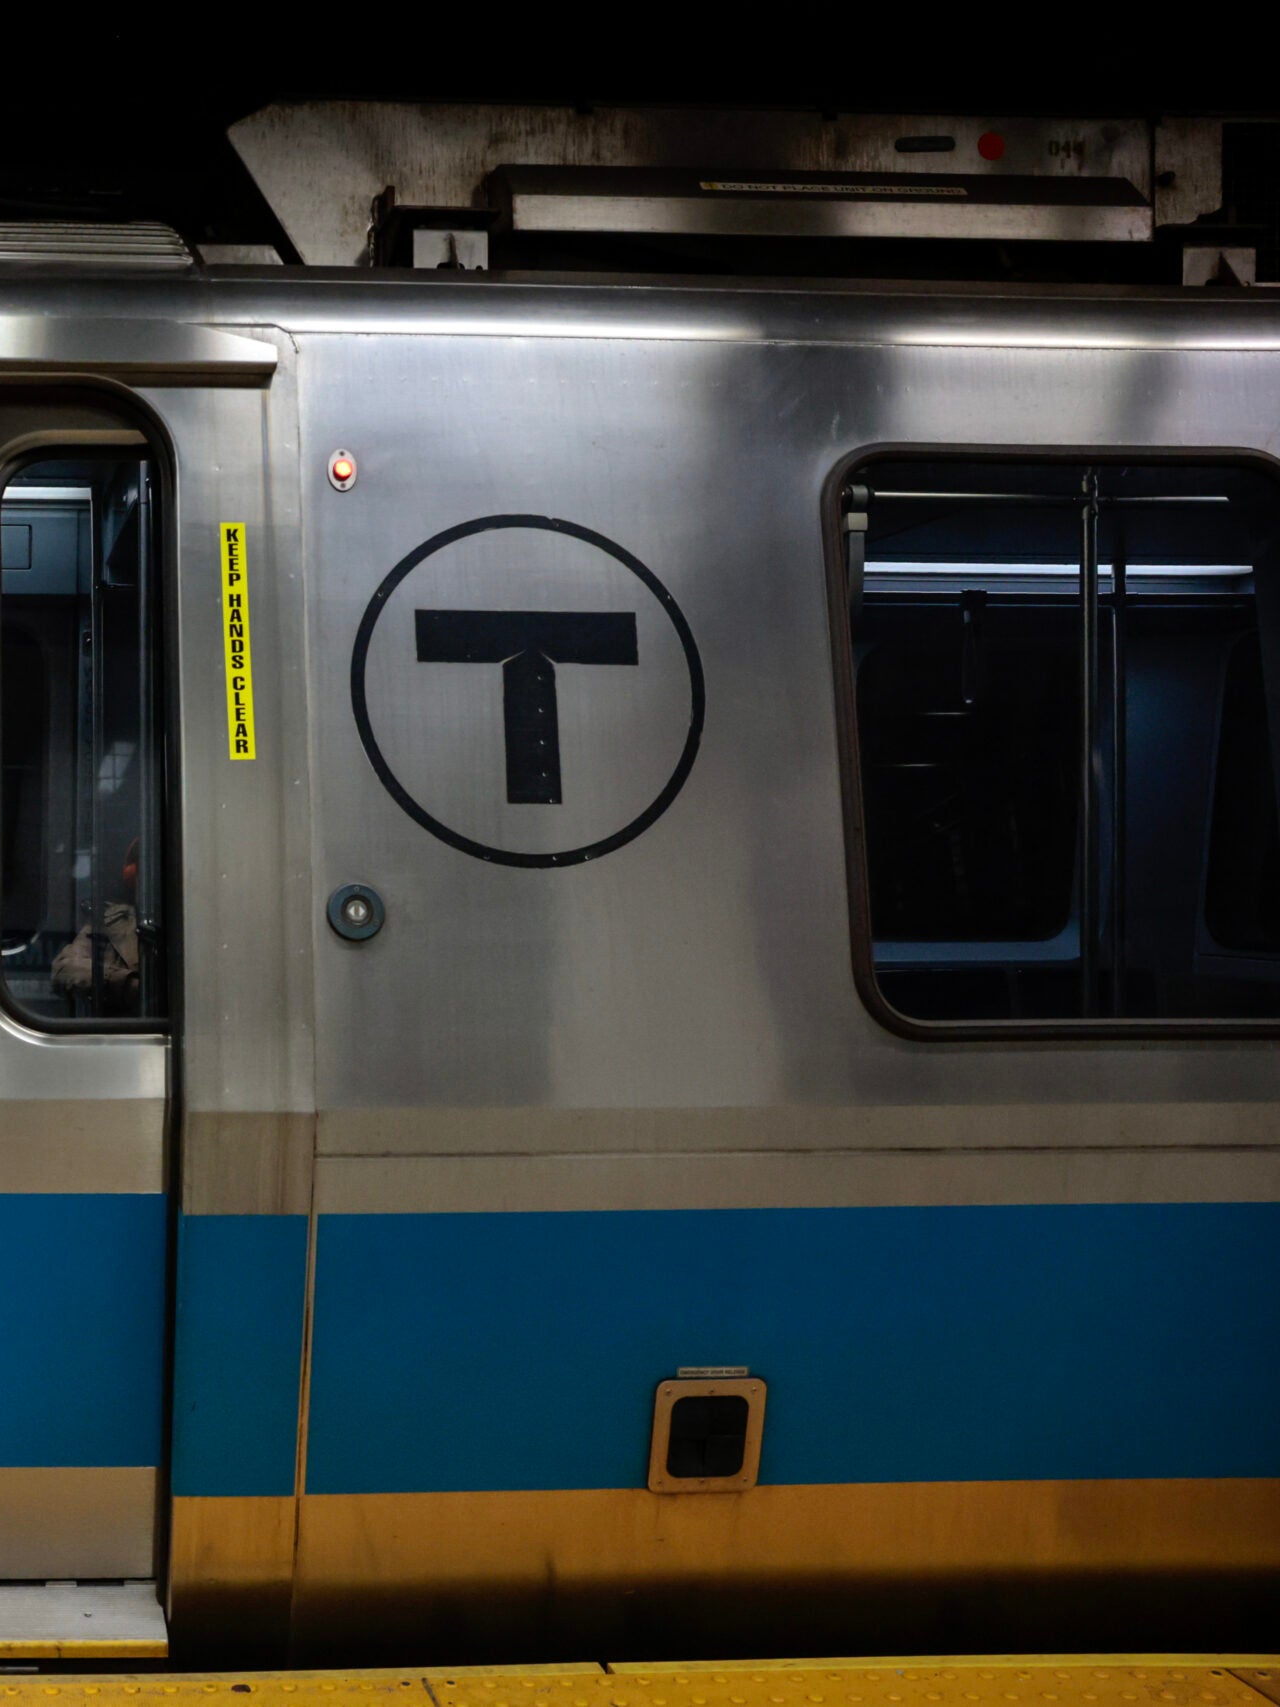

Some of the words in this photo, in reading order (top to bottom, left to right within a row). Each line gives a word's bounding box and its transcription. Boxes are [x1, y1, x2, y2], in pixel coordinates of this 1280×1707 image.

[226, 528, 241, 587] KEEP
[229, 594, 244, 669] HANDS
[232, 676, 249, 754] CLEAR
